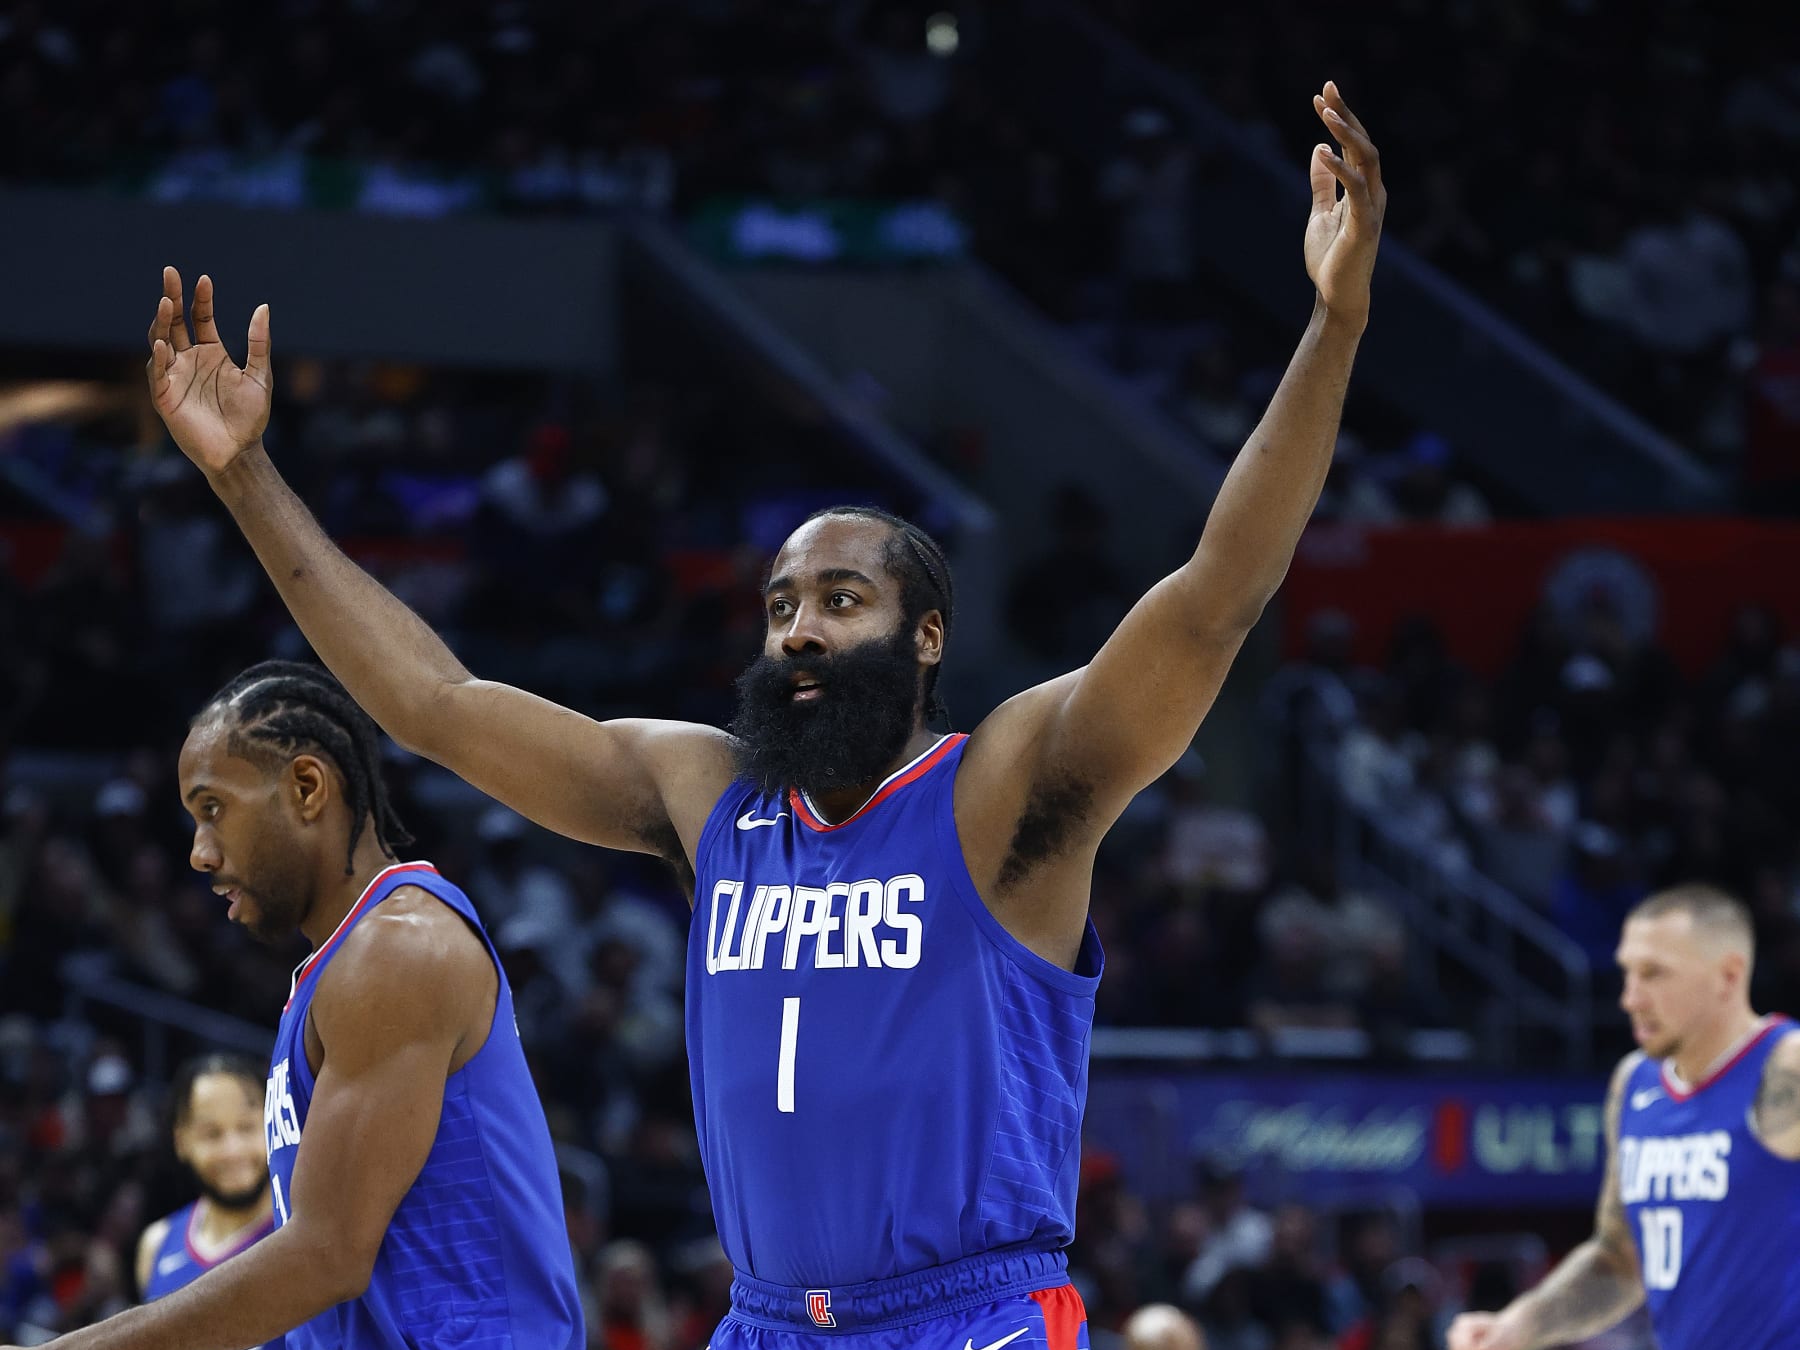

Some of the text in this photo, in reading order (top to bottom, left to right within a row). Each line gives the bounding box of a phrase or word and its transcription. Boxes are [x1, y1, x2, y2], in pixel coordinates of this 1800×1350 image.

[706, 873, 925, 975] CLIPPERS
[777, 997, 801, 1113] 1
[1475, 1103, 1603, 1174] ULT
[1640, 1207, 1683, 1290] 10
